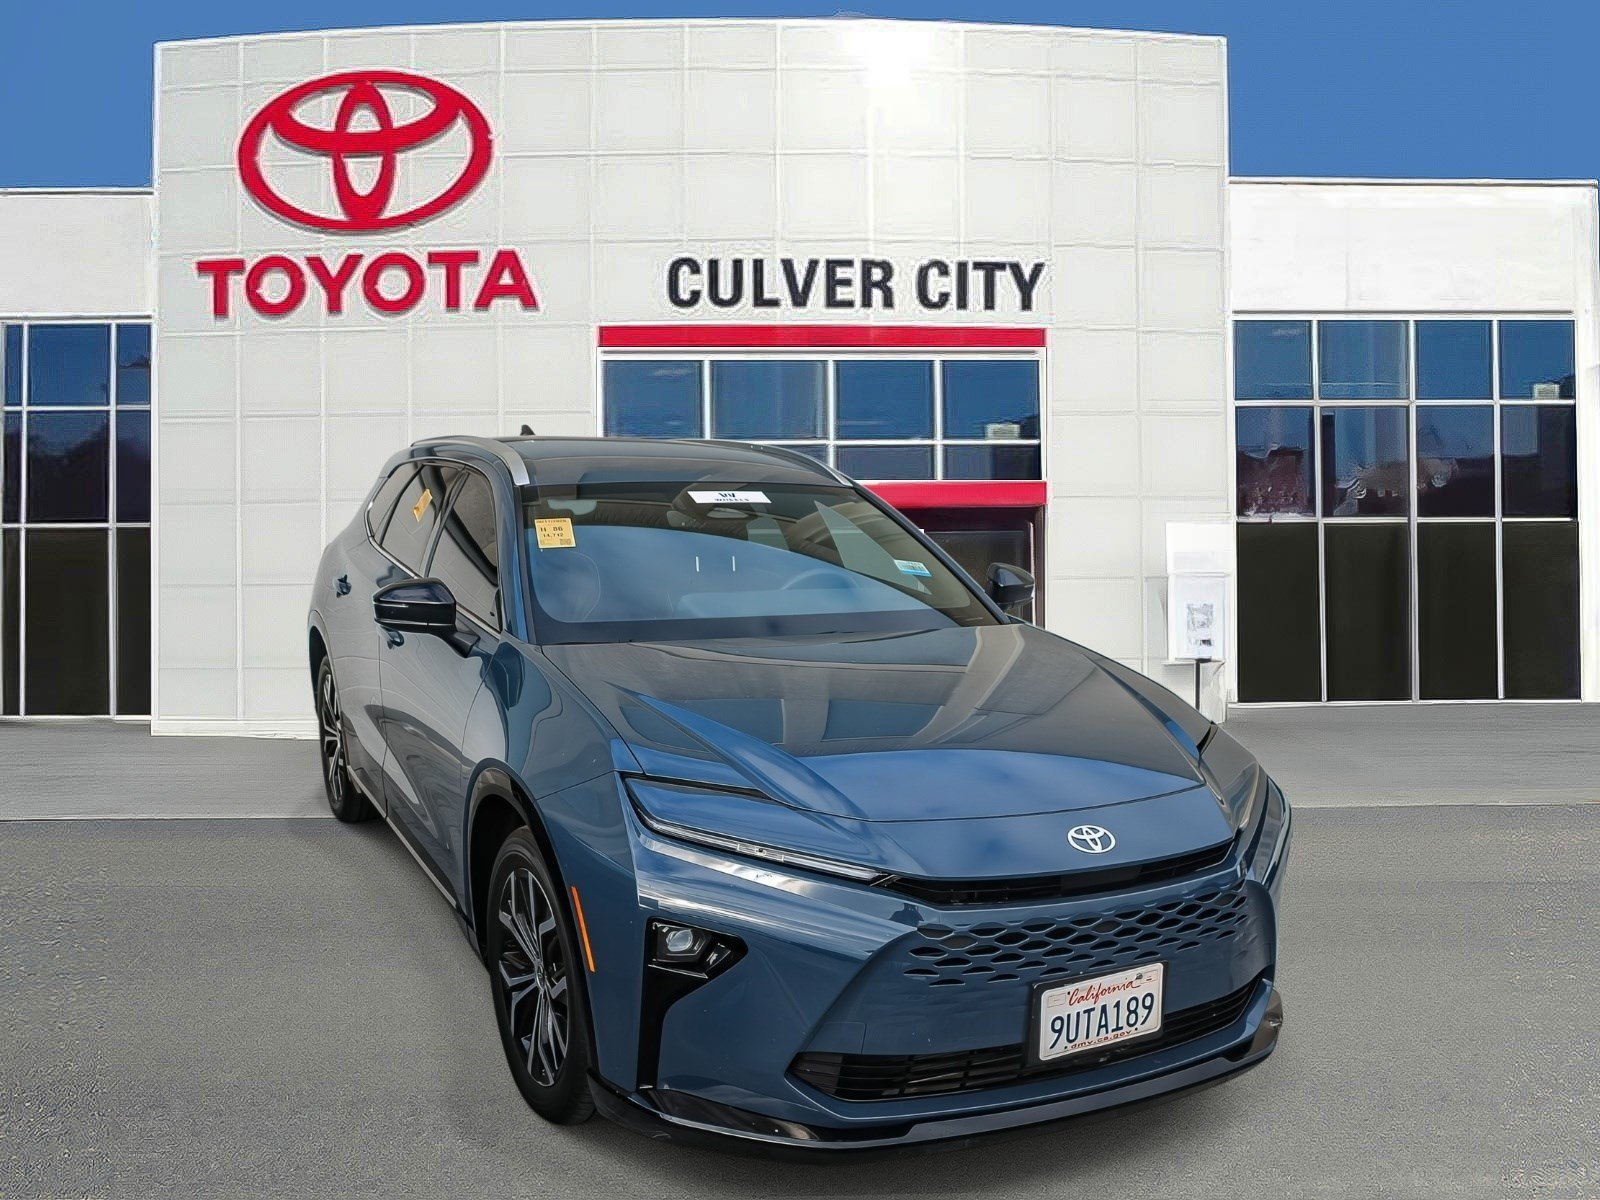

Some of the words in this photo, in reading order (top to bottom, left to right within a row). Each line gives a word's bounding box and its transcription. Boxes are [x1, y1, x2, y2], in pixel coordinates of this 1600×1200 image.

[195, 249, 539, 318] TOYOTA
[667, 257, 896, 309] CULVER
[916, 258, 1046, 311] CITY
[1068, 977, 1141, 1006] California
[1049, 992, 1155, 1050] 9UTA189
[1070, 1029, 1134, 1050] dmv.ca.gov
